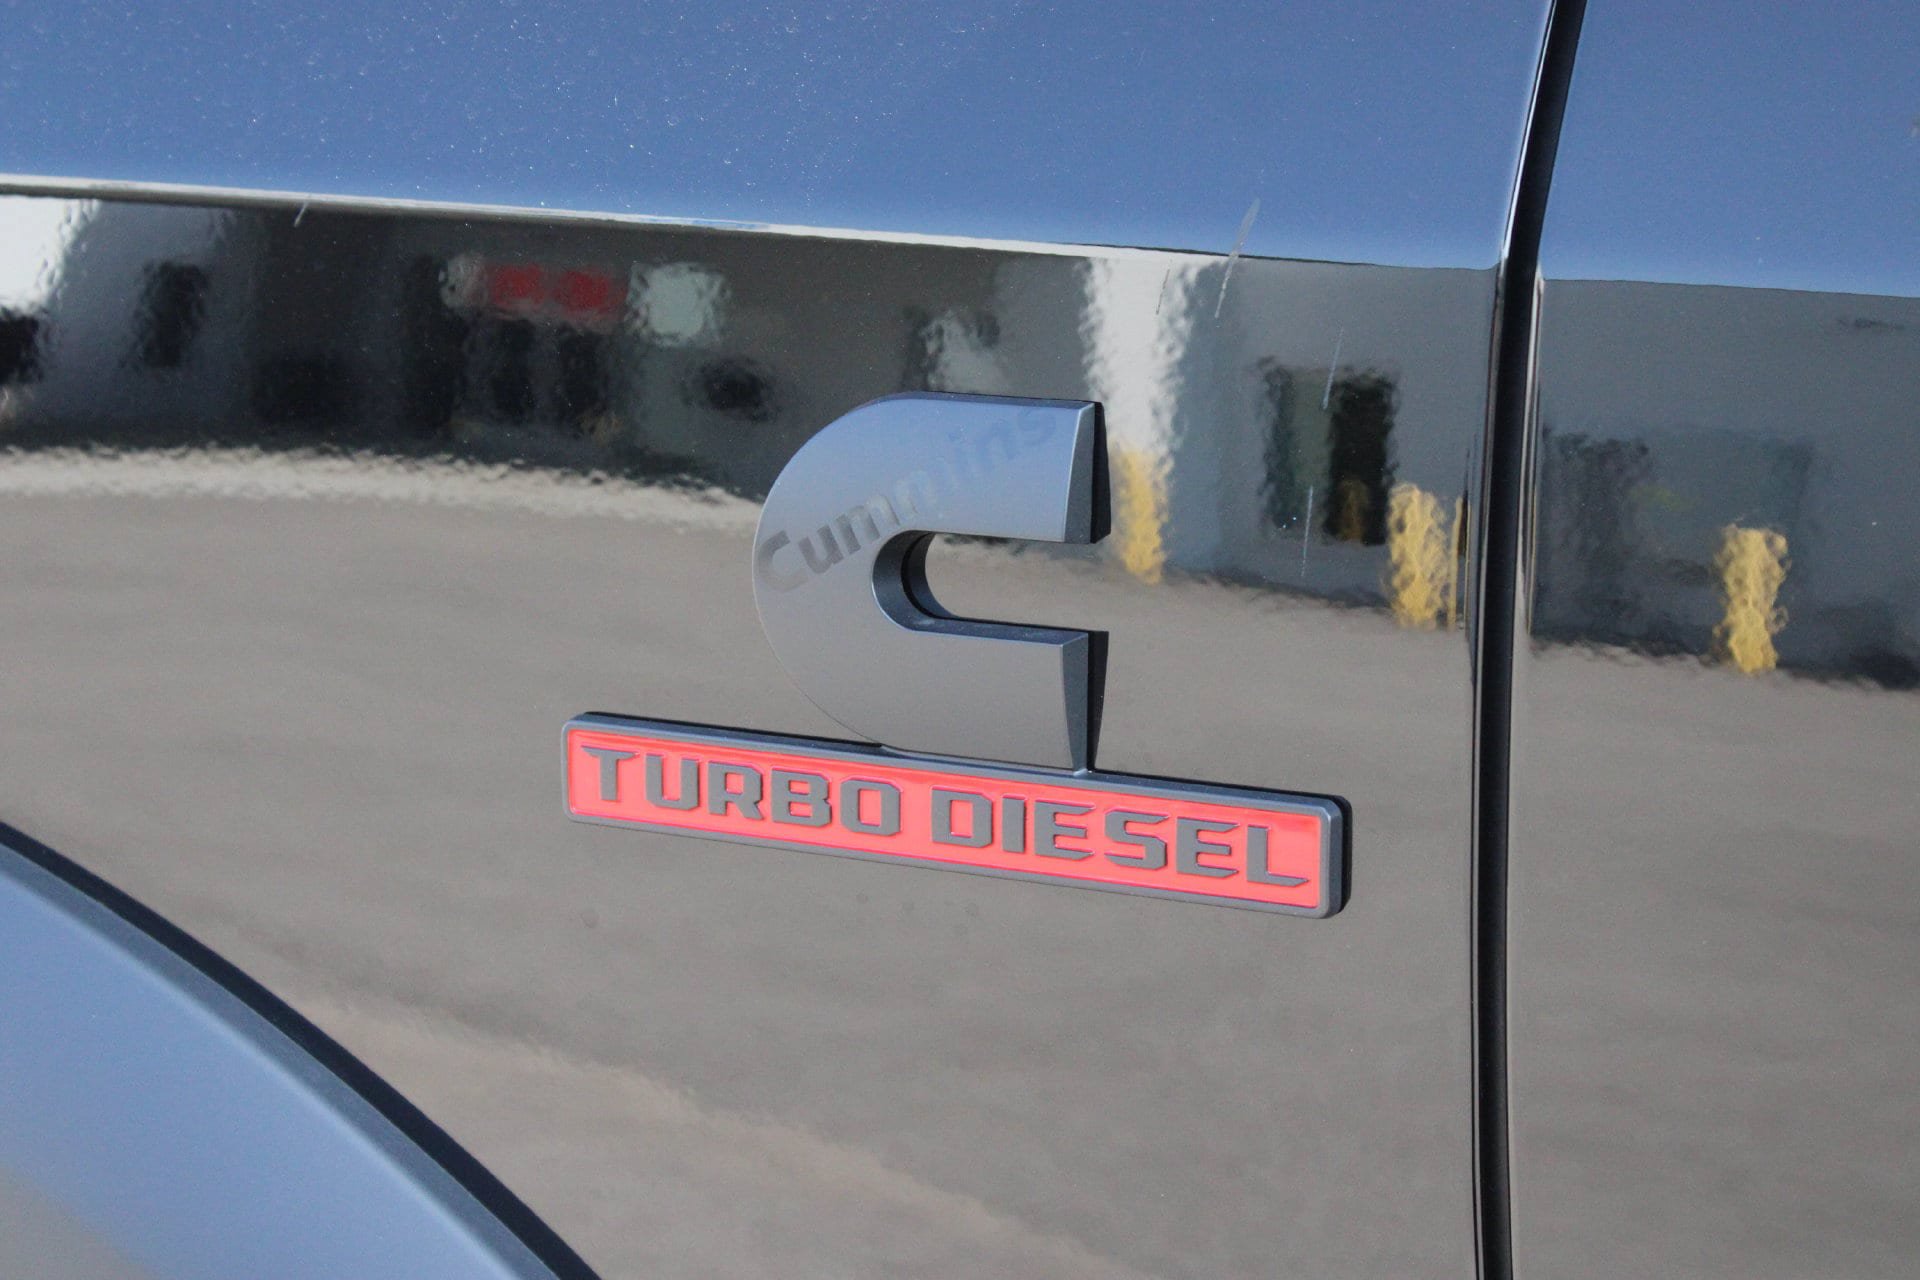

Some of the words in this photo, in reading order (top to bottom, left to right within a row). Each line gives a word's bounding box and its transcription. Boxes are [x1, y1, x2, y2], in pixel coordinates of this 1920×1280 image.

[757, 405, 1058, 592] Cummins
[581, 745, 901, 836] TURBO
[931, 787, 1309, 887] DIESEL
